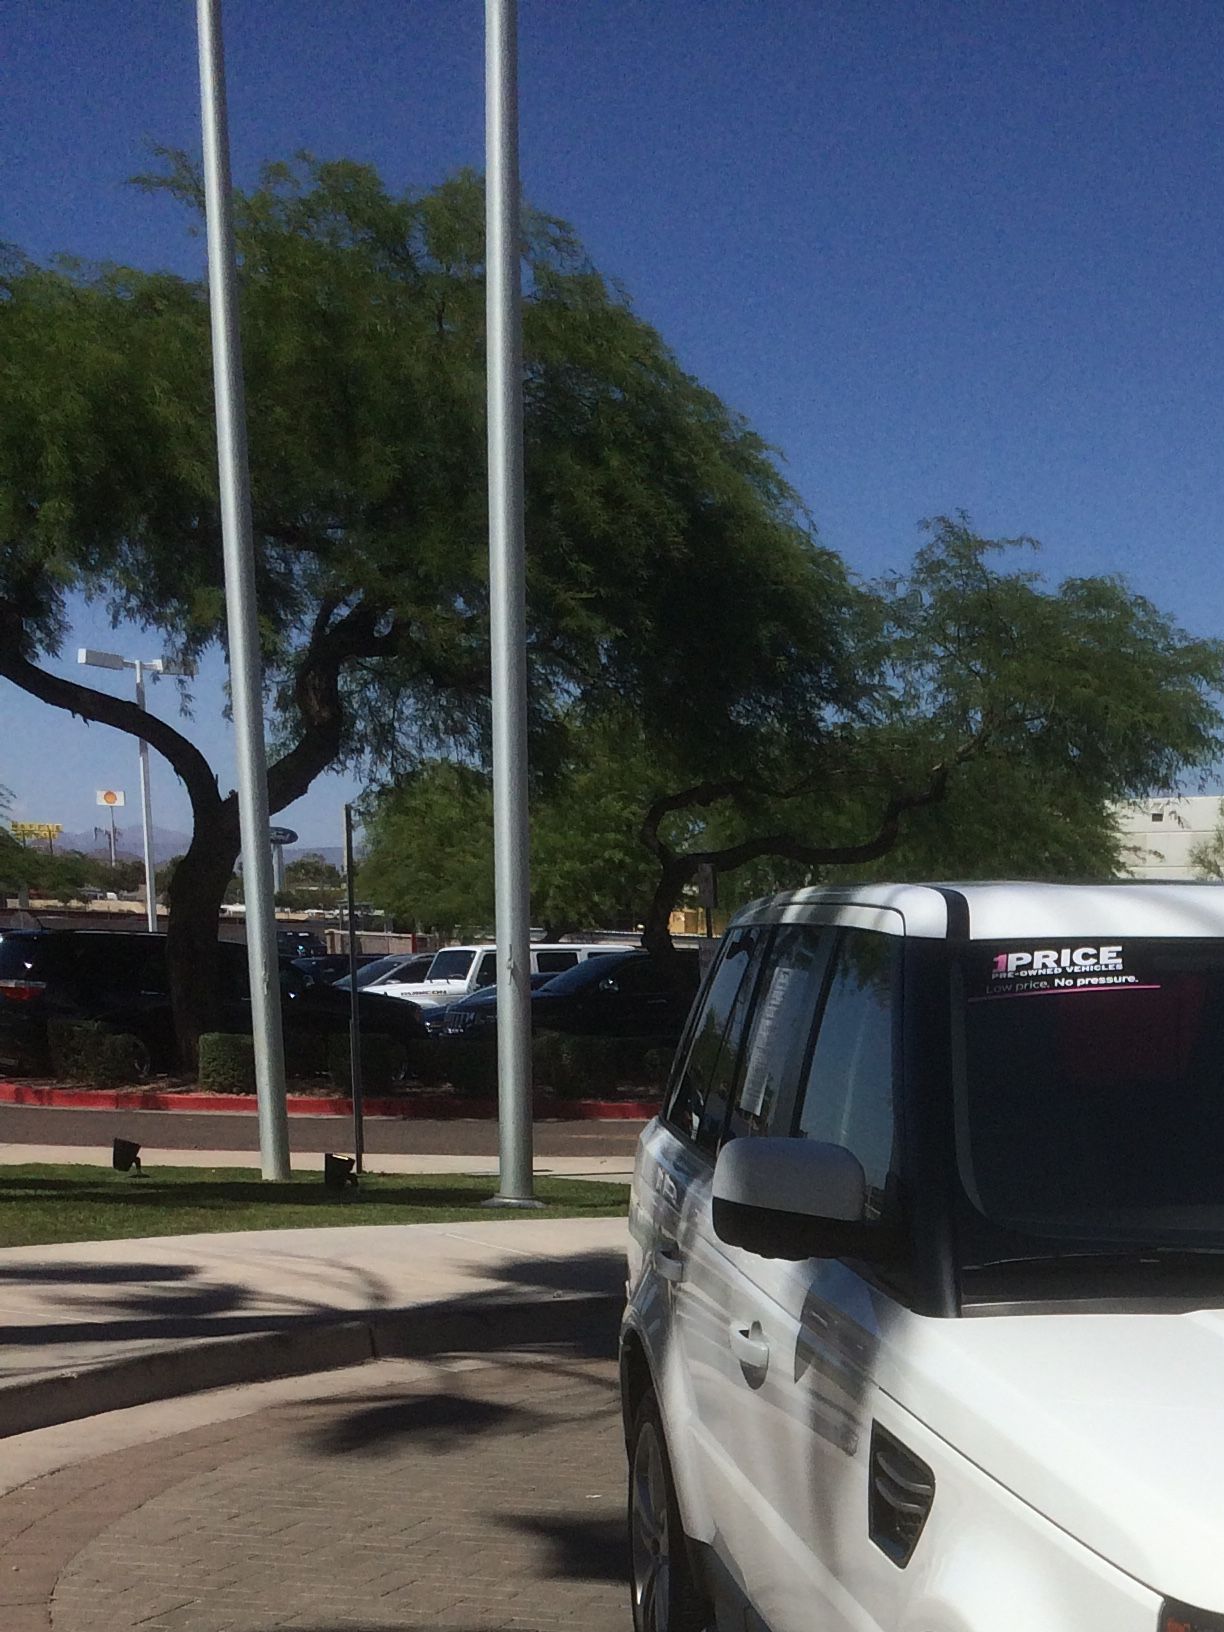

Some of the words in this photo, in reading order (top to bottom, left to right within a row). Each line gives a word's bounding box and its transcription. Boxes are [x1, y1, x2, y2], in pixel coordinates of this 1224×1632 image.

[991, 967, 1063, 980] PRE-OWNED
[1065, 963, 1124, 974] VEHICLES
[986, 983, 1013, 995] Low
[1015, 979, 1051, 992] price.
[1054, 977, 1074, 987] No
[1076, 973, 1139, 987] pressure.
